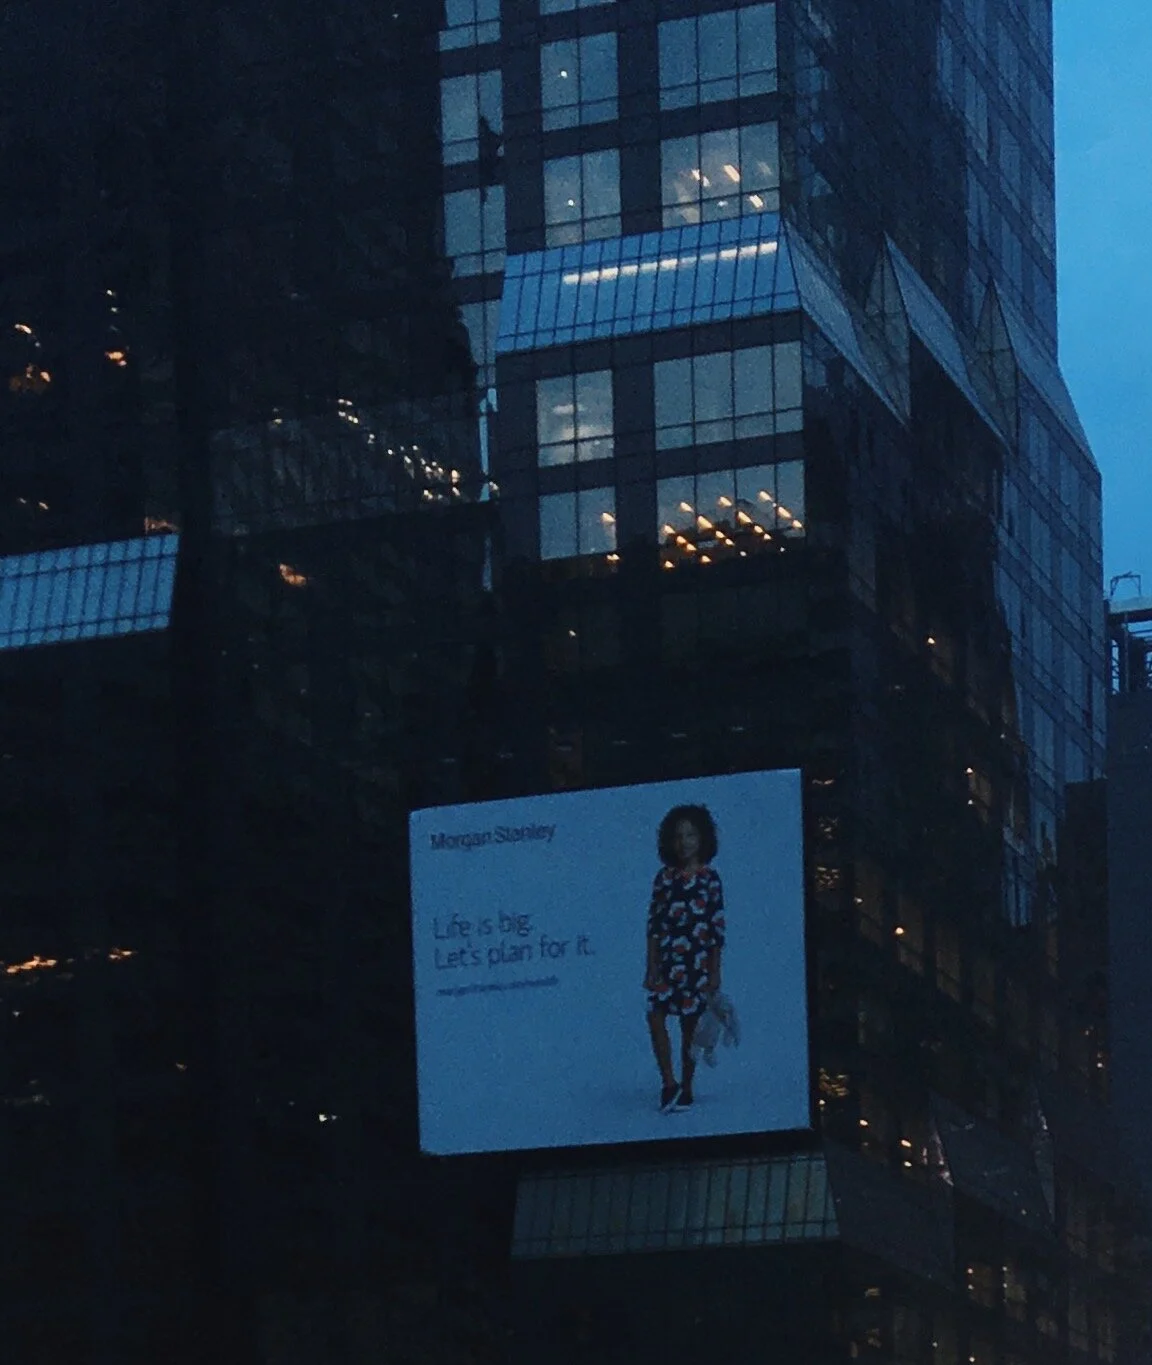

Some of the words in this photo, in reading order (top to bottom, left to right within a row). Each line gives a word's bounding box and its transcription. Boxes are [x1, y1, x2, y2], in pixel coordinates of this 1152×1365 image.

[431, 832, 491, 851] Morgan
[494, 824, 557, 843] Stanley
[433, 912, 471, 939] Life
[478, 918, 493, 936] is
[434, 940, 481, 970] Let's
[488, 940, 533, 968] plan
[540, 934, 569, 958] for
[577, 934, 595, 956] it.
